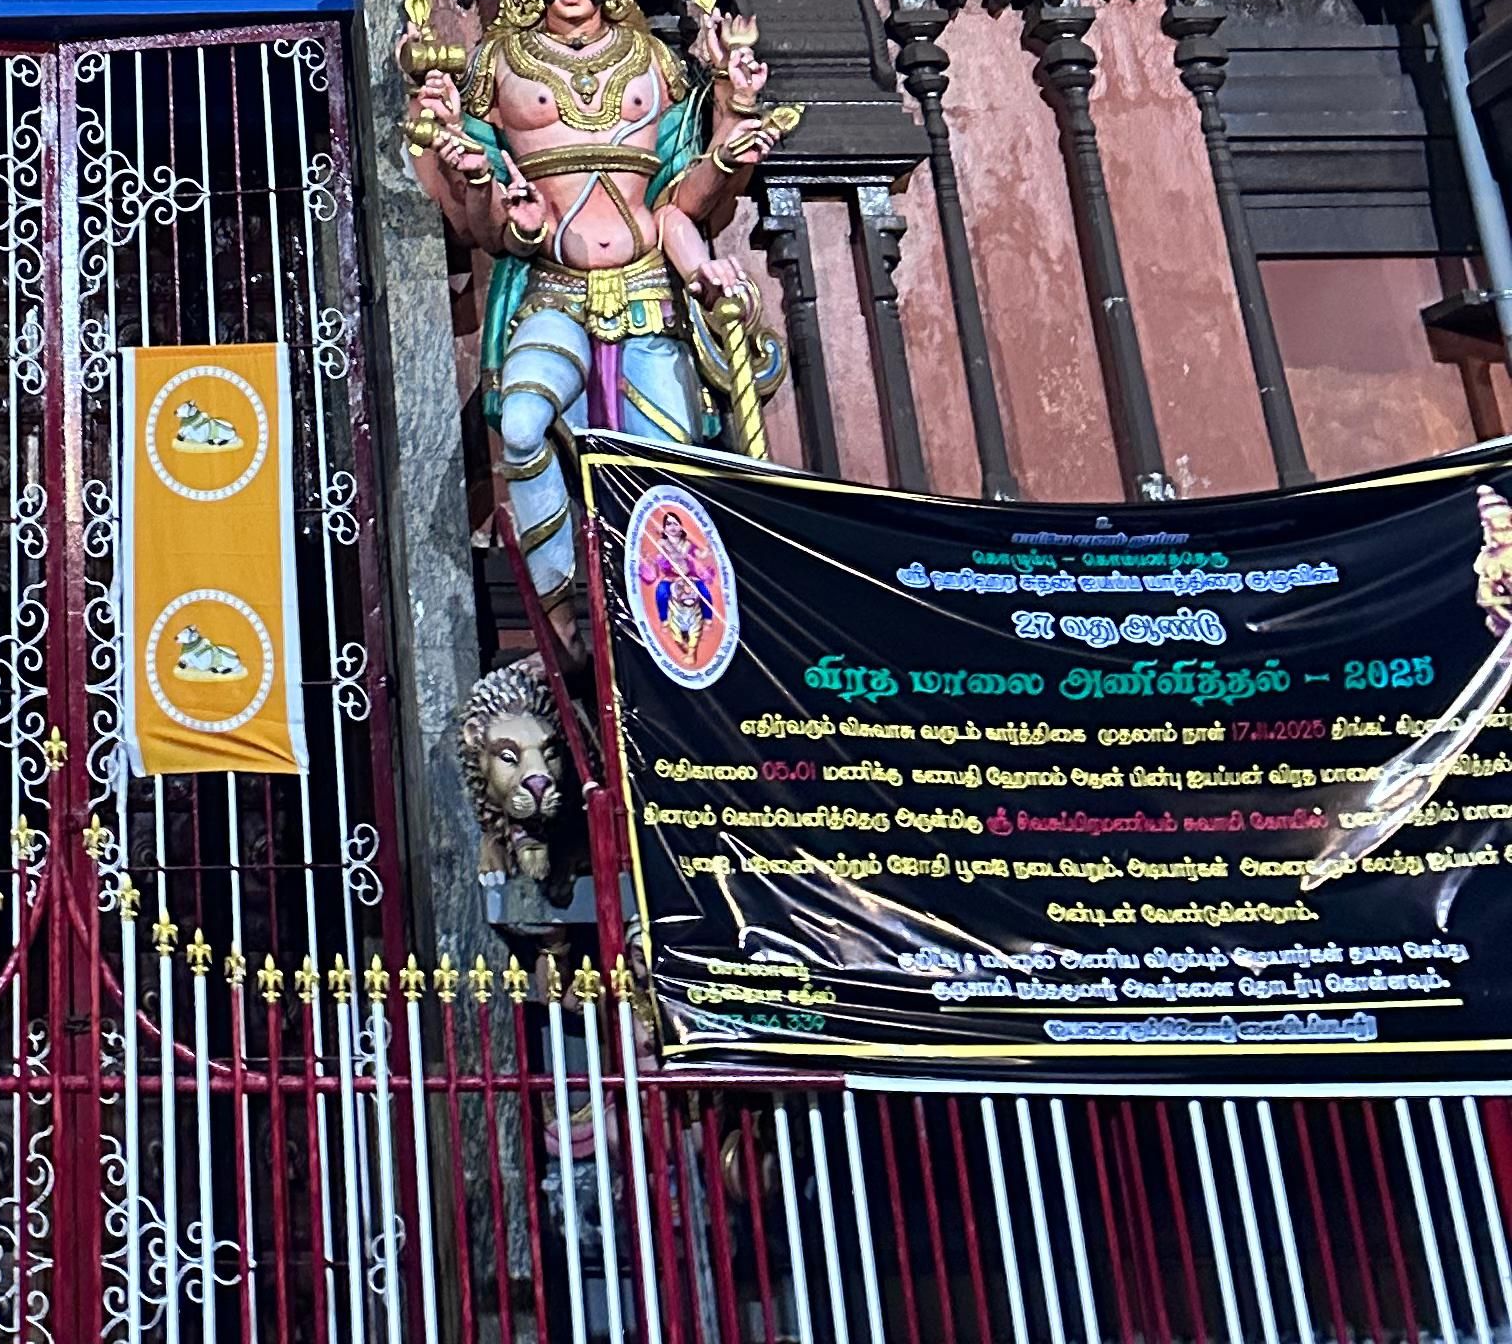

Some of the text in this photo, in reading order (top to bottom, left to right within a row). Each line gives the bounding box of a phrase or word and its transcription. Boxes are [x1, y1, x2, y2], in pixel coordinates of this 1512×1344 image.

[1011, 607, 1227, 649] 27 வது ஆண்டு
[803, 654, 899, 702] விரத
[911, 669, 1045, 694] மாலை
[1058, 659, 1292, 707] அணிவித்தல்
[1343, 656, 1435, 691] 2025
[740, 713, 836, 739] எதிர்வரும்
[919, 720, 982, 744] வருடம்
[984, 721, 1087, 746] கார்த்திகை
[1097, 722, 1178, 746] முதலாம்
[1182, 721, 1226, 745] நாள்
[654, 758, 758, 782] அதிகாலை
[760, 761, 817, 781] 05.01
[822, 760, 904, 786] மணிக்கு
[911, 764, 982, 788] கணபதி
[1070, 766, 1124, 790] அதன்
[1129, 765, 1183, 791] பின்பு
[1186, 765, 1263, 789] ஐயப்பன்
[1268, 763, 1317, 788] விரத
[954, 859, 1010, 883] பூஜை
[1046, 901, 1137, 927] அன்புடன்
